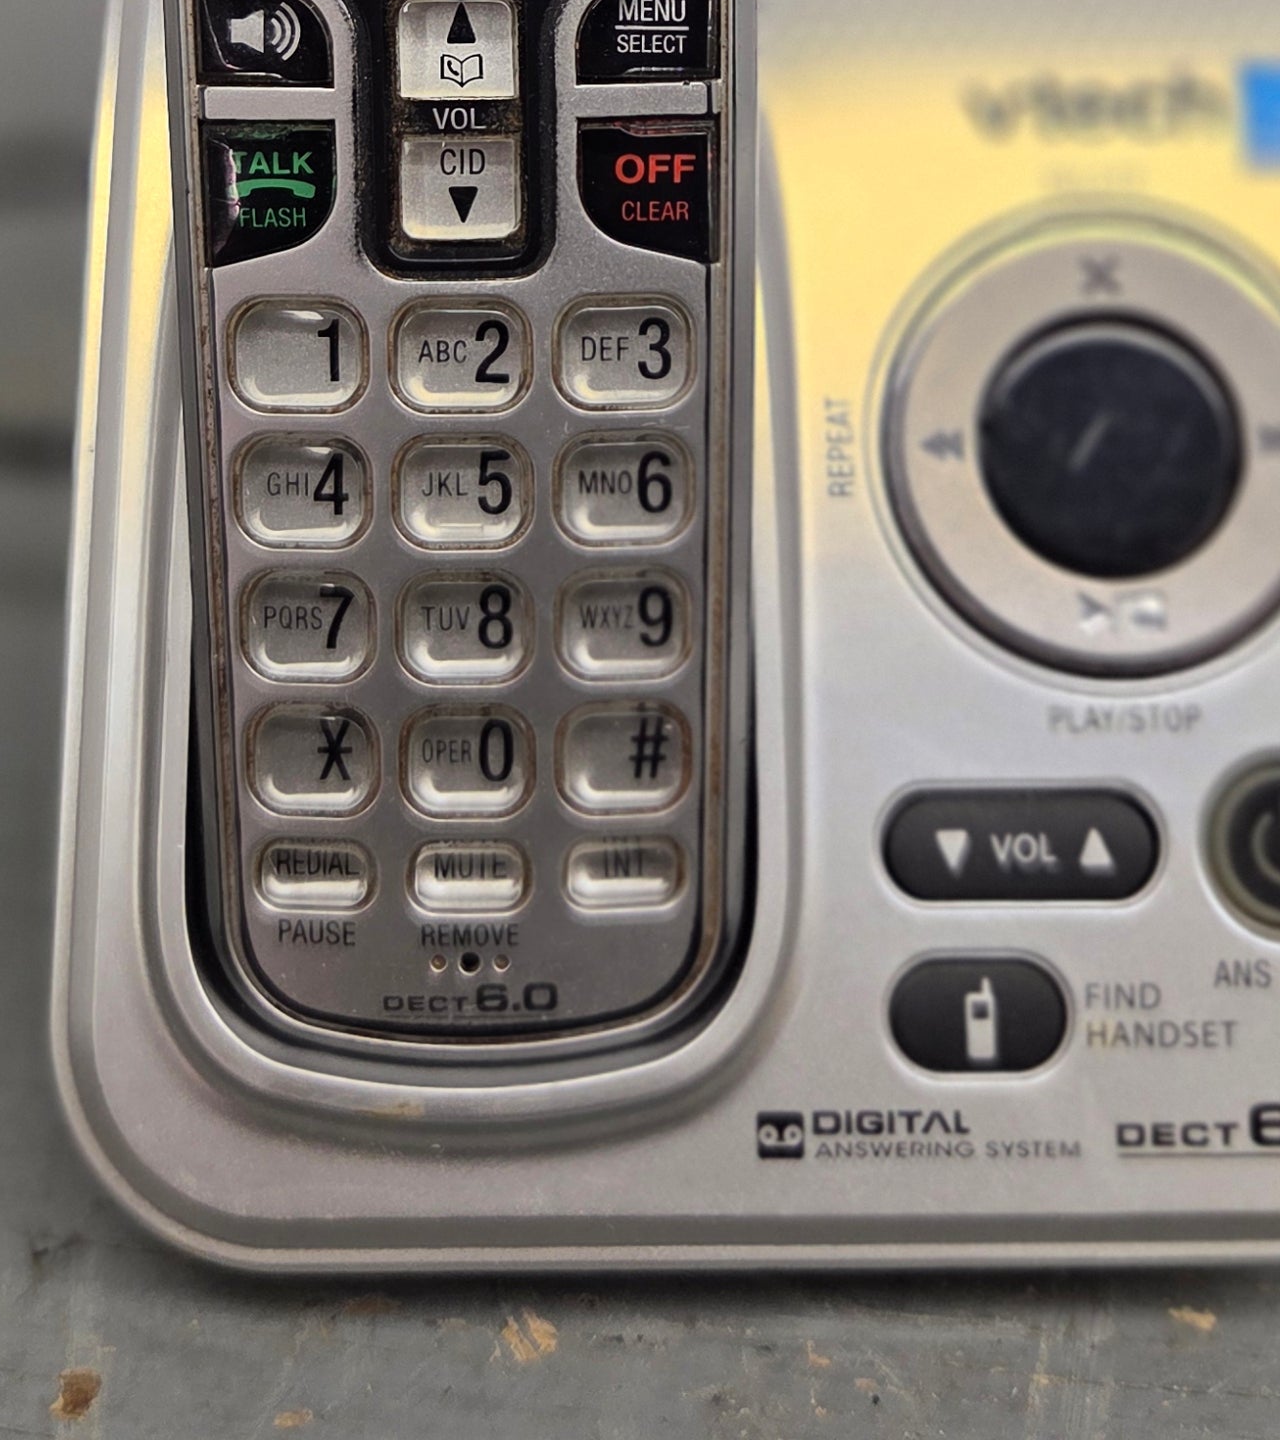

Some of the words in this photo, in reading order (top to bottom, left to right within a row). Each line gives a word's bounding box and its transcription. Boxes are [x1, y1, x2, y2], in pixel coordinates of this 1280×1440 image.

[616, 34, 689, 54] SELECT
[432, 107, 487, 130] VOL
[233, 151, 316, 175] TALK
[440, 148, 487, 177] CID
[614, 153, 697, 185] OFF
[239, 207, 307, 229] FLASH
[621, 200, 690, 222] CLEAR
[316, 317, 341, 383] 1
[418, 338, 468, 364] ABC
[473, 318, 511, 384] 2
[580, 335, 630, 362] DEF
[636, 316, 673, 381] 3
[823, 398, 855, 498] REPEAT
[266, 471, 310, 497] GHI
[313, 452, 350, 516] 4
[421, 471, 469, 498] JKL
[477, 449, 513, 516] 5
[578, 469, 633, 496] MNO
[637, 449, 673, 513] 6
[263, 605, 323, 630] PQRS
[320, 584, 356, 650] 7
[422, 605, 470, 632] TUV
[477, 584, 514, 649] 8
[579, 603, 635, 630] WXYZ
[637, 584, 674, 647] 9
[421, 737, 472, 764] OPER
[478, 718, 515, 782] 0
[628, 715, 671, 780] #
[274, 845, 361, 877] REDIAL
[989, 833, 1058, 866] VOL
[434, 852, 508, 881] MUTE
[278, 919, 357, 948] PAUSE
[421, 923, 520, 948] REMOVE
[1213, 959, 1272, 989] ANS
[383, 994, 468, 1013] DECT
[475, 982, 559, 1013] 6.0
[1085, 981, 1162, 1011] FIND
[1086, 1020, 1239, 1049] HANDSET
[811, 1109, 971, 1136] DIGITAL
[1115, 1120, 1240, 1149] DECT
[814, 1140, 975, 1159] ANSWERING
[985, 1140, 1082, 1159] SYSTEM
